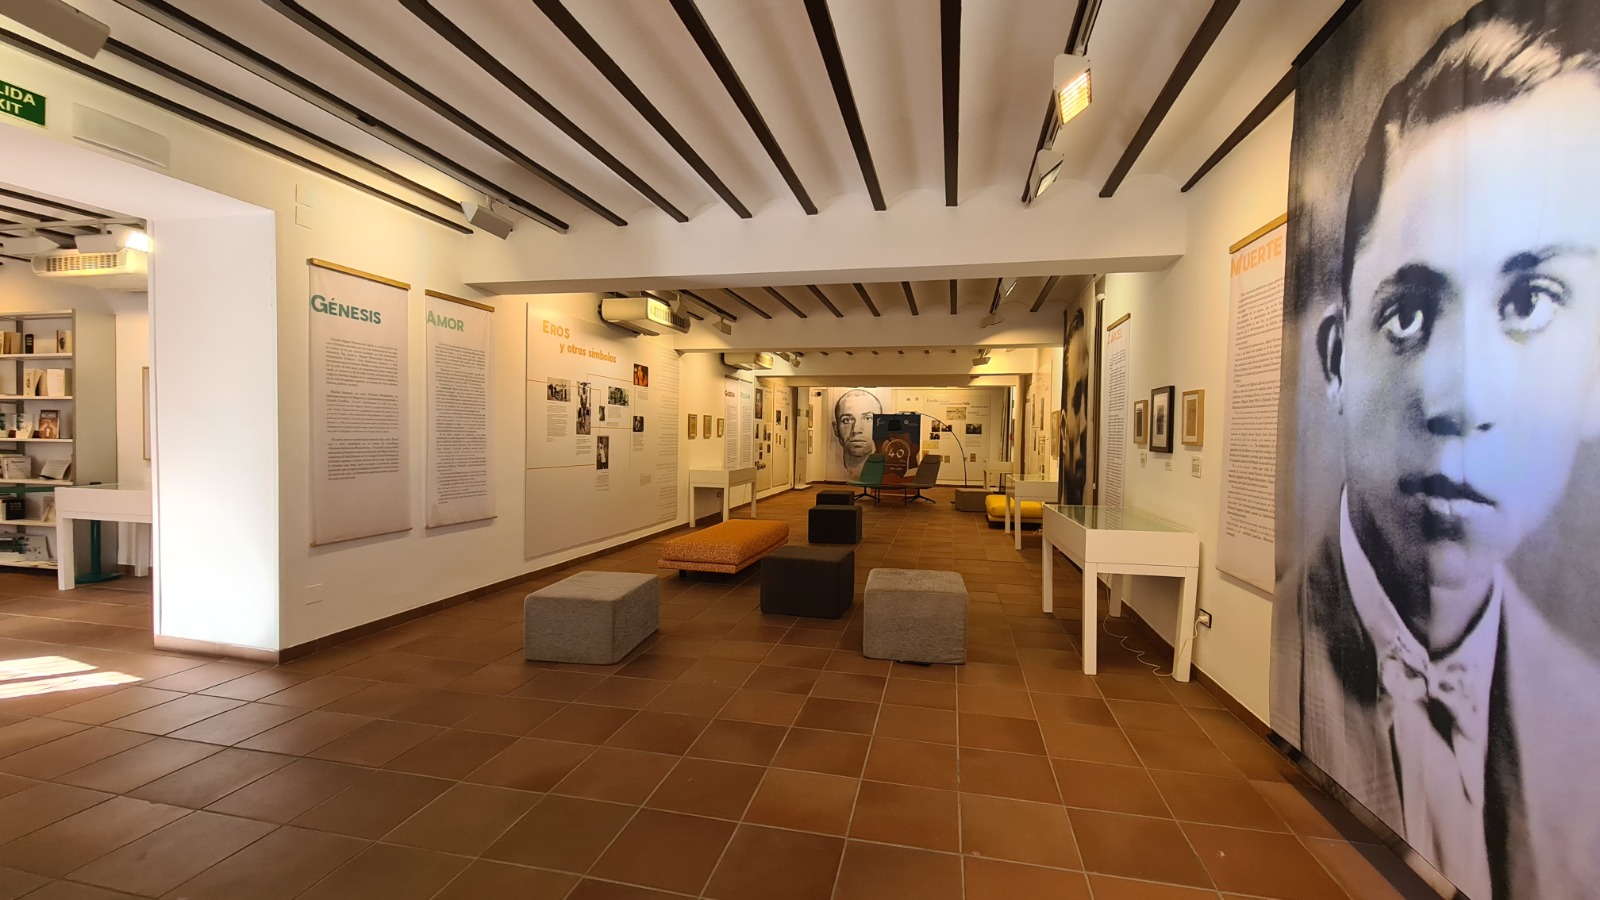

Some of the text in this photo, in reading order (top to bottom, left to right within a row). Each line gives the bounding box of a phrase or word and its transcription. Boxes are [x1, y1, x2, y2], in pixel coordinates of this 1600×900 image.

[1230, 235, 1282, 278] MUERTE
[311, 294, 381, 324] GÉNESIS
[426, 310, 464, 332] AMOR
[542, 319, 570, 339] EROS
[559, 343, 617, 363] y otros símbolos
[888, 448, 905, 459] 40
